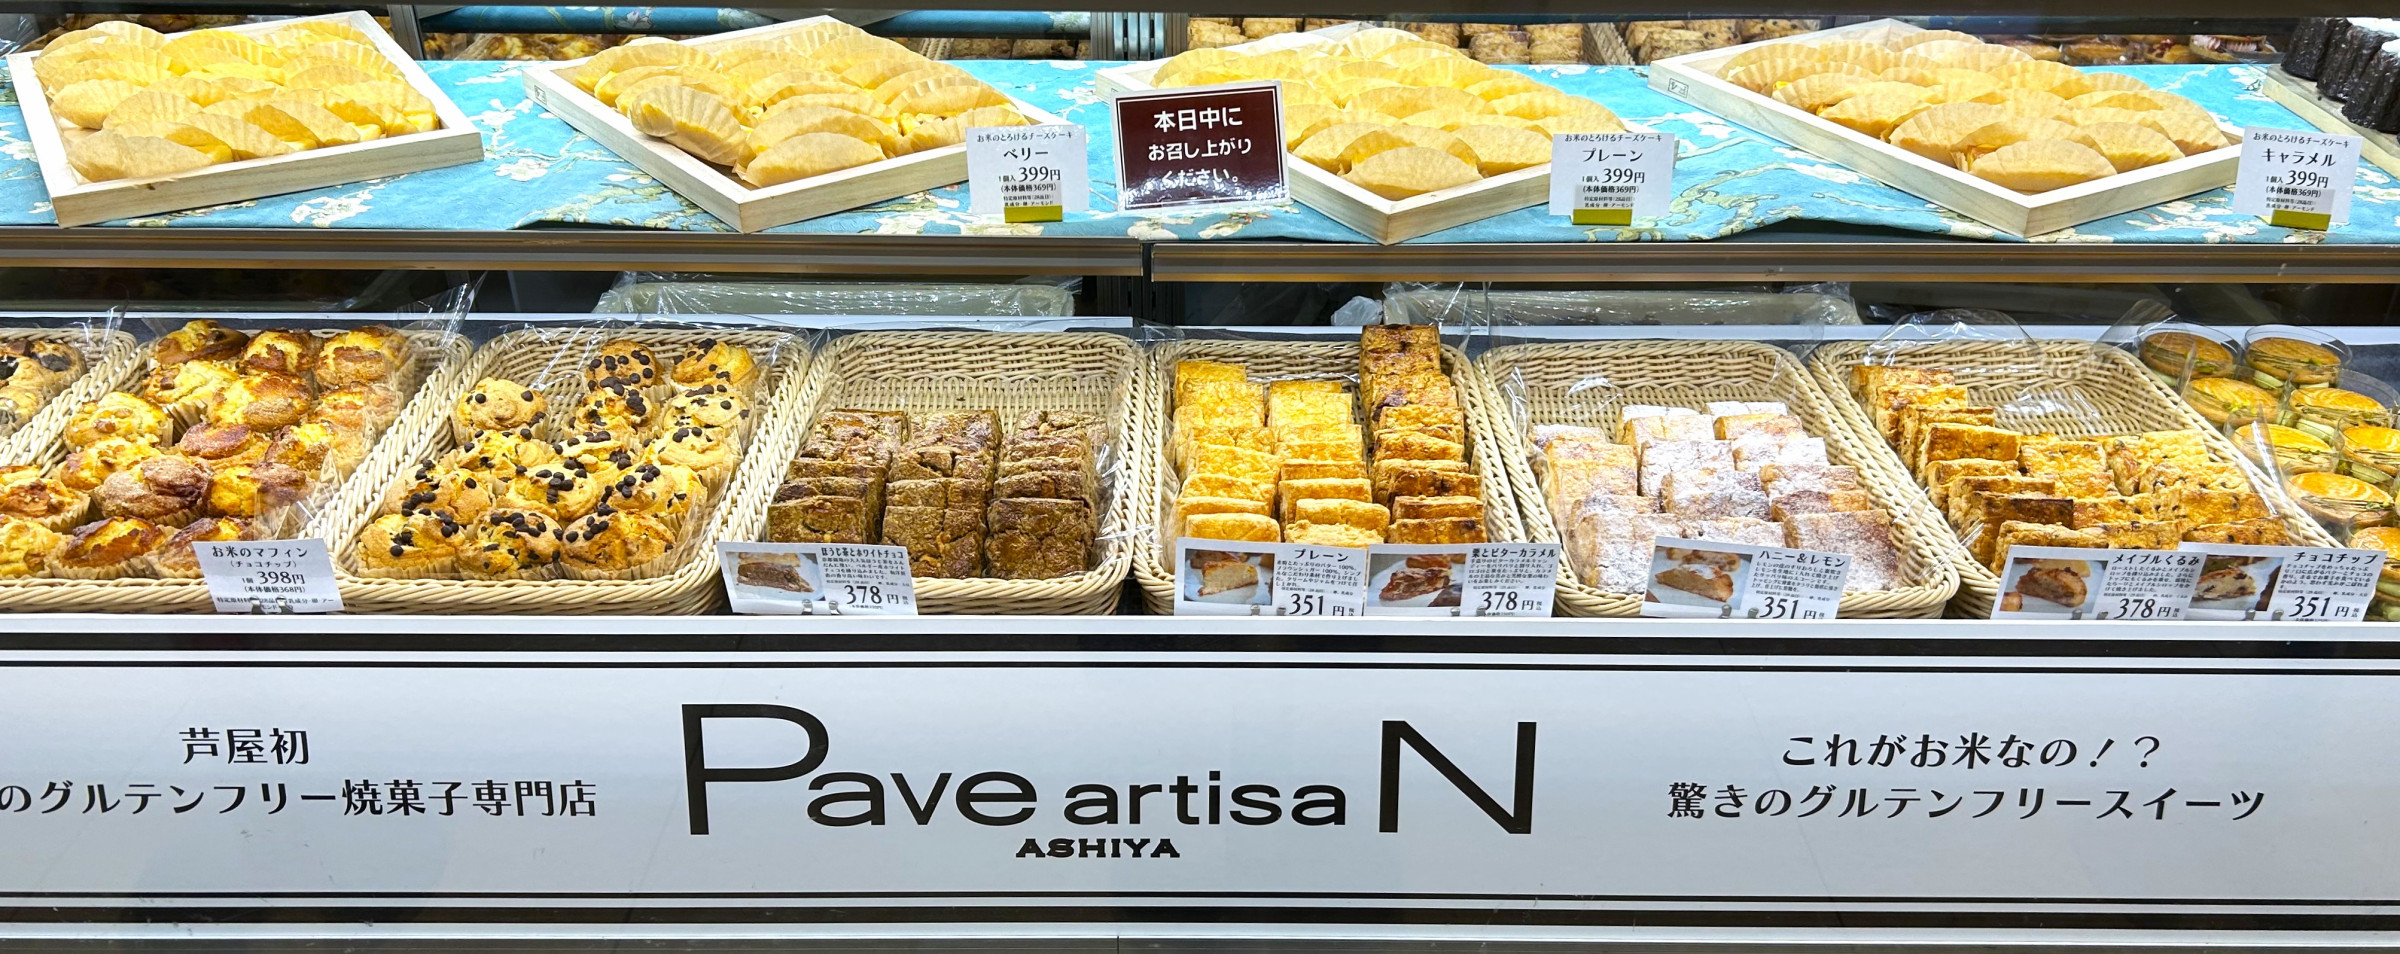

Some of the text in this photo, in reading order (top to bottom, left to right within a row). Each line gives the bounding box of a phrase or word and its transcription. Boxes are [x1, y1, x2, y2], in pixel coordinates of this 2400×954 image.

[1154, 107, 1242, 132] 本日中に
[977, 131, 1072, 142] お米のとろけるチーズケーキ
[1564, 134, 1662, 142] お米のとろけるチーズケーキ
[2253, 132, 2350, 148] お米のとろけるチーズケーキ
[1004, 148, 1048, 161] ベリー
[1148, 138, 1252, 161] お召し上がり
[1582, 148, 1643, 162] プレーン
[2262, 148, 2336, 167] キャラメル
[1018, 166, 1060, 182] 399円
[1162, 168, 1239, 188] ください。
[1602, 168, 1645, 184] 399円
[2286, 170, 2328, 188] 399円
[212, 545, 308, 558] お米のマフィン
[821, 547, 904, 559] ほうじ茶とホワイトチョコ
[1294, 548, 1349, 562] プレーン
[1472, 548, 1556, 558] 栗とビターカラメル
[1759, 550, 1846, 568] ハニー&レモン
[2112, 554, 2200, 566] メイプルくるみ
[2294, 551, 2378, 564] チョコチップ
[256, 571, 306, 585] 398円
[844, 584, 900, 605] 378円
[1288, 593, 1344, 616] 351円
[1760, 596, 1817, 619] 351円
[2113, 598, 2172, 620] 378円
[2288, 596, 2350, 618] 351円
[179, 727, 309, 766] 芦屋初
[1781, 732, 2161, 769] これがお米なの！？
[681, 703, 1038, 836] Pave
[0, 779, 597, 818] のグルテンフリー焼菓子専門店
[1667, 782, 2265, 822] 驚きのグルテンフリースイーツ
[1015, 837, 1181, 859] ASHIYA
